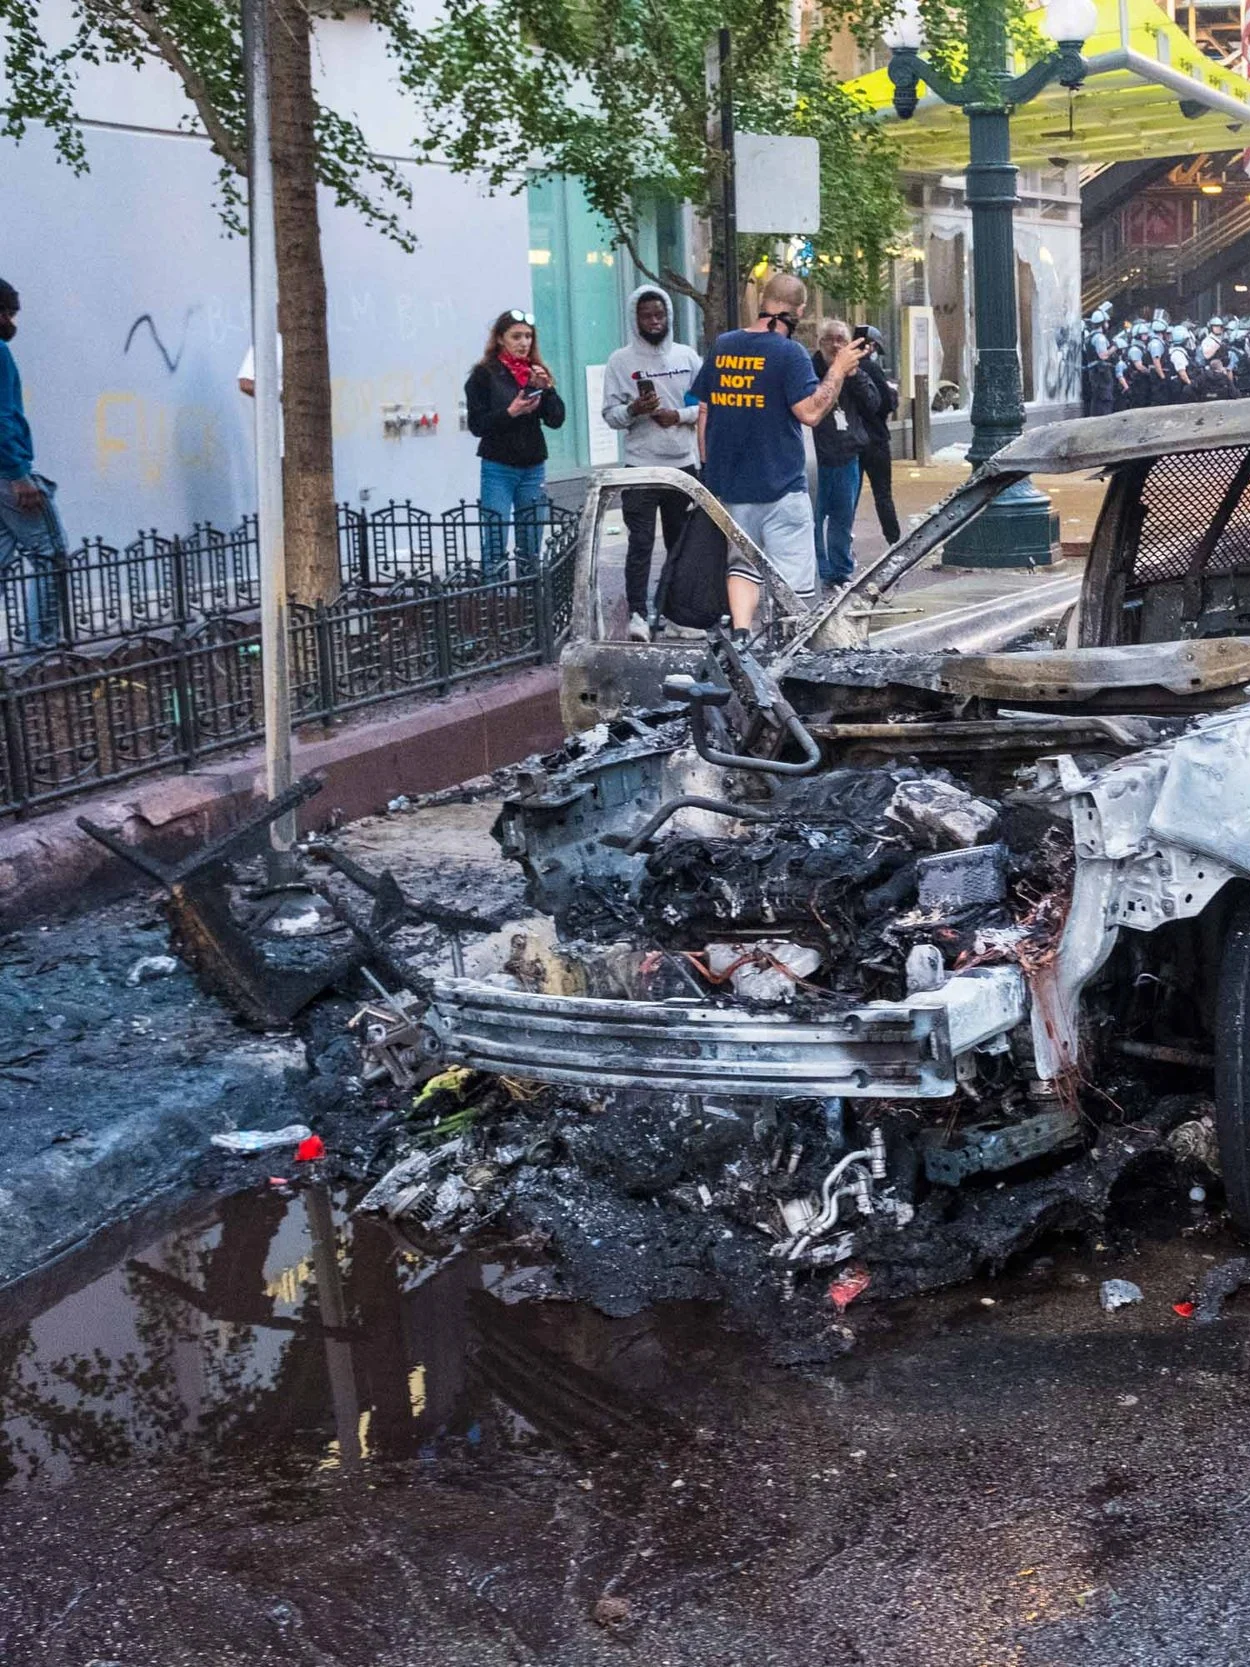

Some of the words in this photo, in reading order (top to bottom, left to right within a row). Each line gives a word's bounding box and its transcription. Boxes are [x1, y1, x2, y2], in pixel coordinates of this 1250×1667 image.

[715, 355, 766, 370] UNITE
[632, 369, 690, 380] Champion
[720, 374, 755, 388] NOT
[711, 392, 766, 408] INCITE
